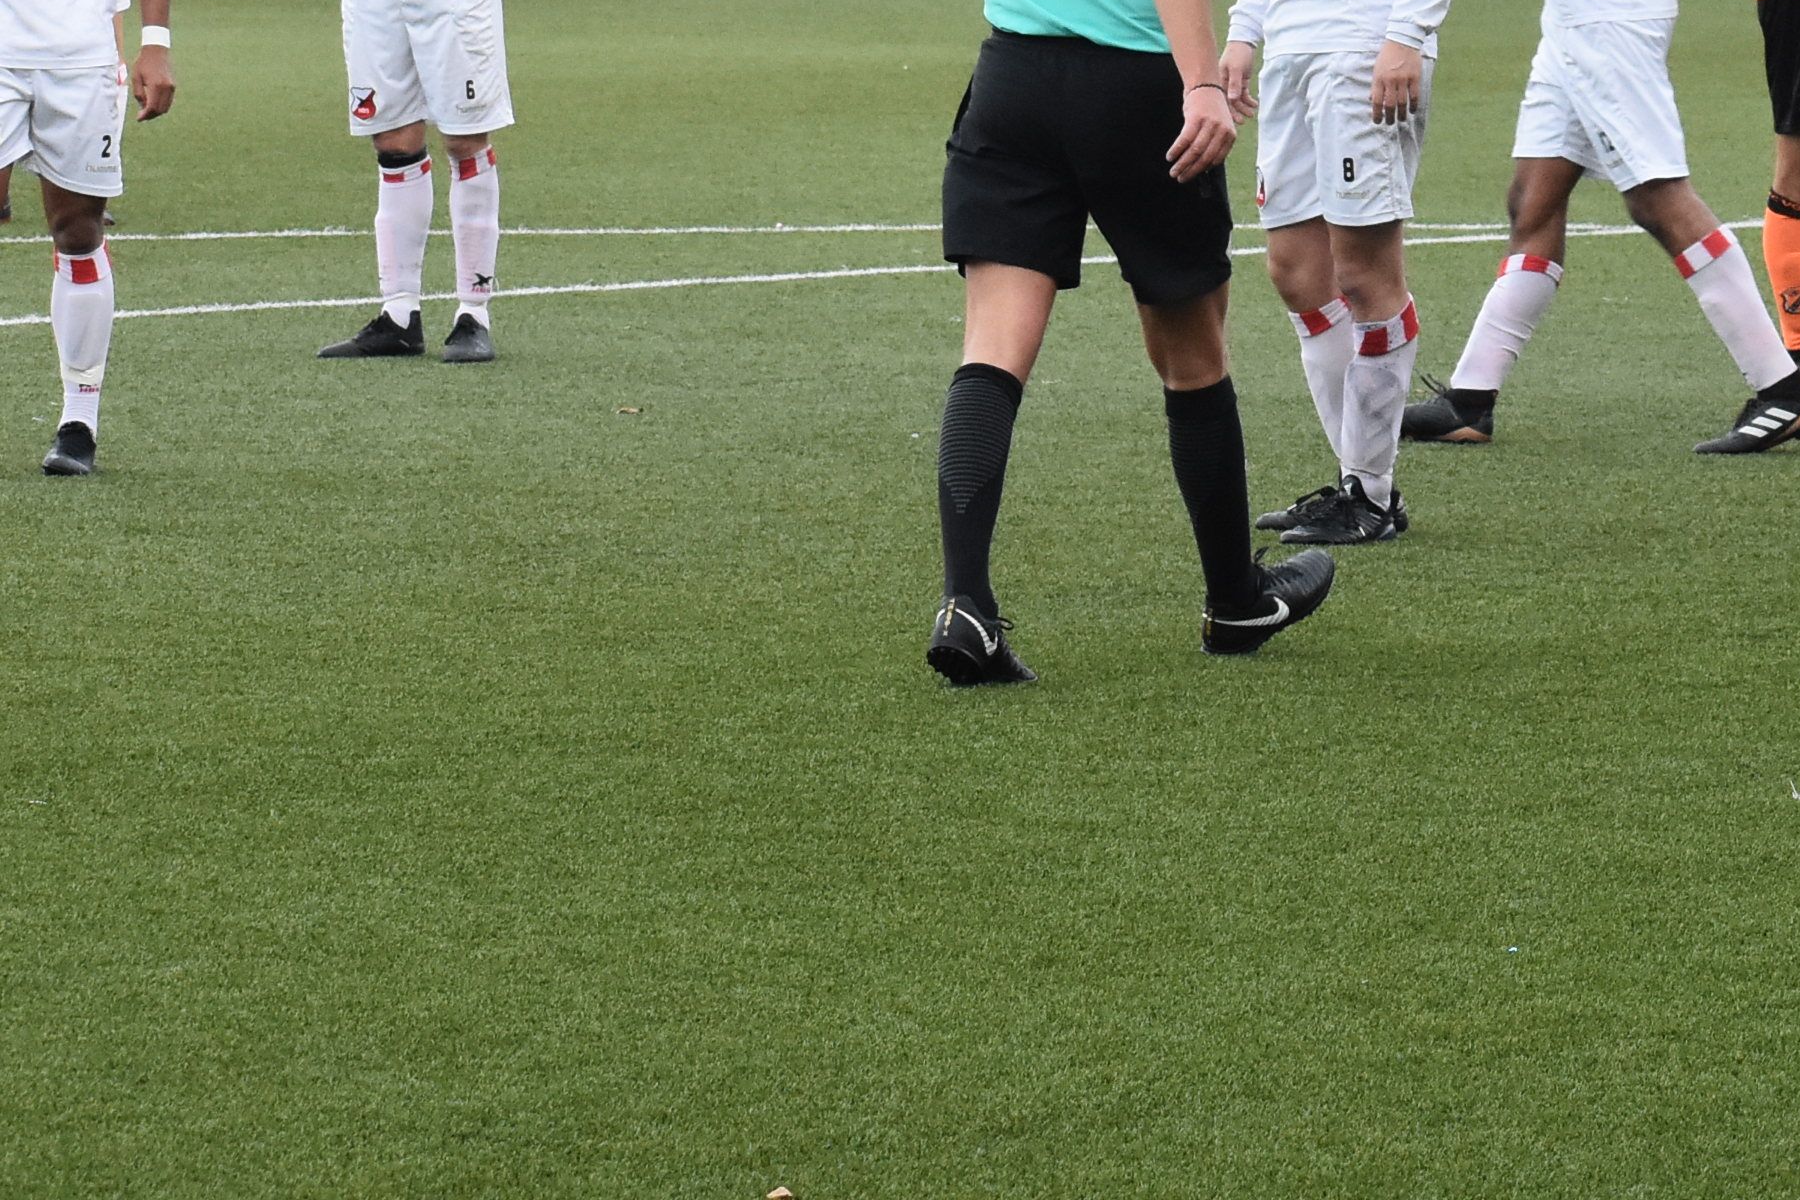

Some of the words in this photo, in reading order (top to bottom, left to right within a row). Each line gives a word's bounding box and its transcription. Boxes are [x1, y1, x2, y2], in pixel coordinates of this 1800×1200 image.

[465, 79, 476, 100] 6
[101, 134, 112, 158] 2
[1342, 157, 1355, 182] 8
